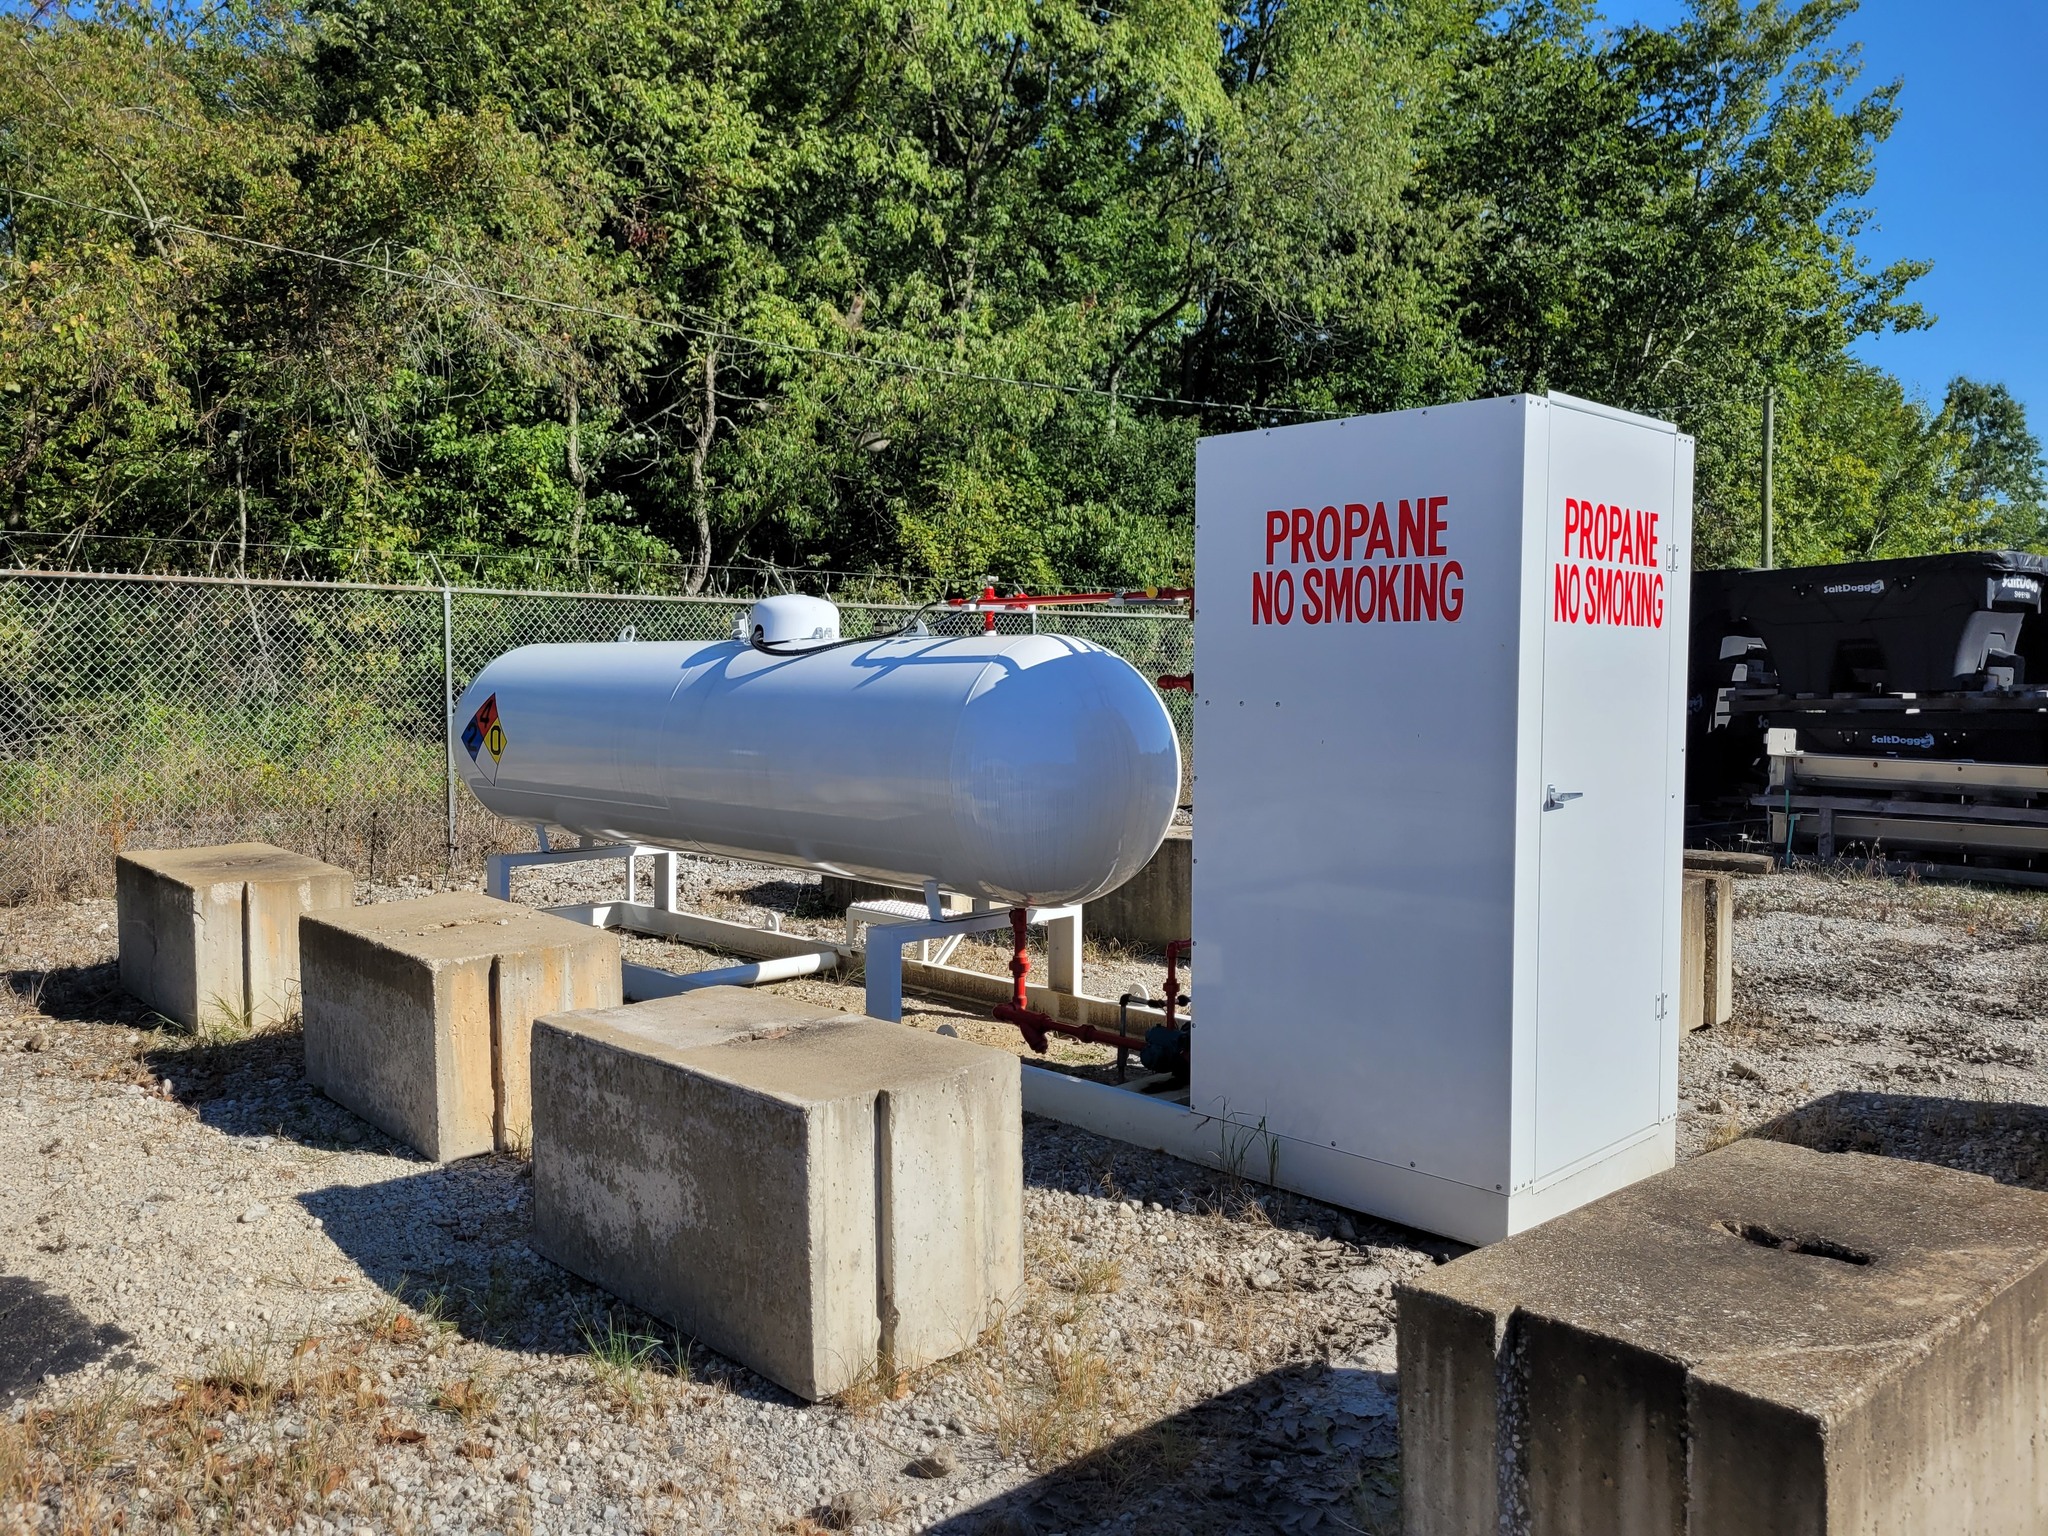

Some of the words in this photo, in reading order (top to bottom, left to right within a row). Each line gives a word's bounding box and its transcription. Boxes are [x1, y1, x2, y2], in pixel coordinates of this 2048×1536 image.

[1266, 496, 1448, 565] PROPANE
[1564, 496, 1660, 568] PROPANE
[1252, 570, 1295, 625] NO
[1302, 561, 1465, 625] SMOKING
[1554, 562, 1581, 625] NO
[1583, 565, 1665, 629] SMOKING
[1823, 583, 1872, 594] SaltDogg
[480, 699, 494, 729] 4
[467, 722, 478, 752] 2
[490, 725, 501, 756] 0
[1871, 735, 1921, 746] SaltDogg
